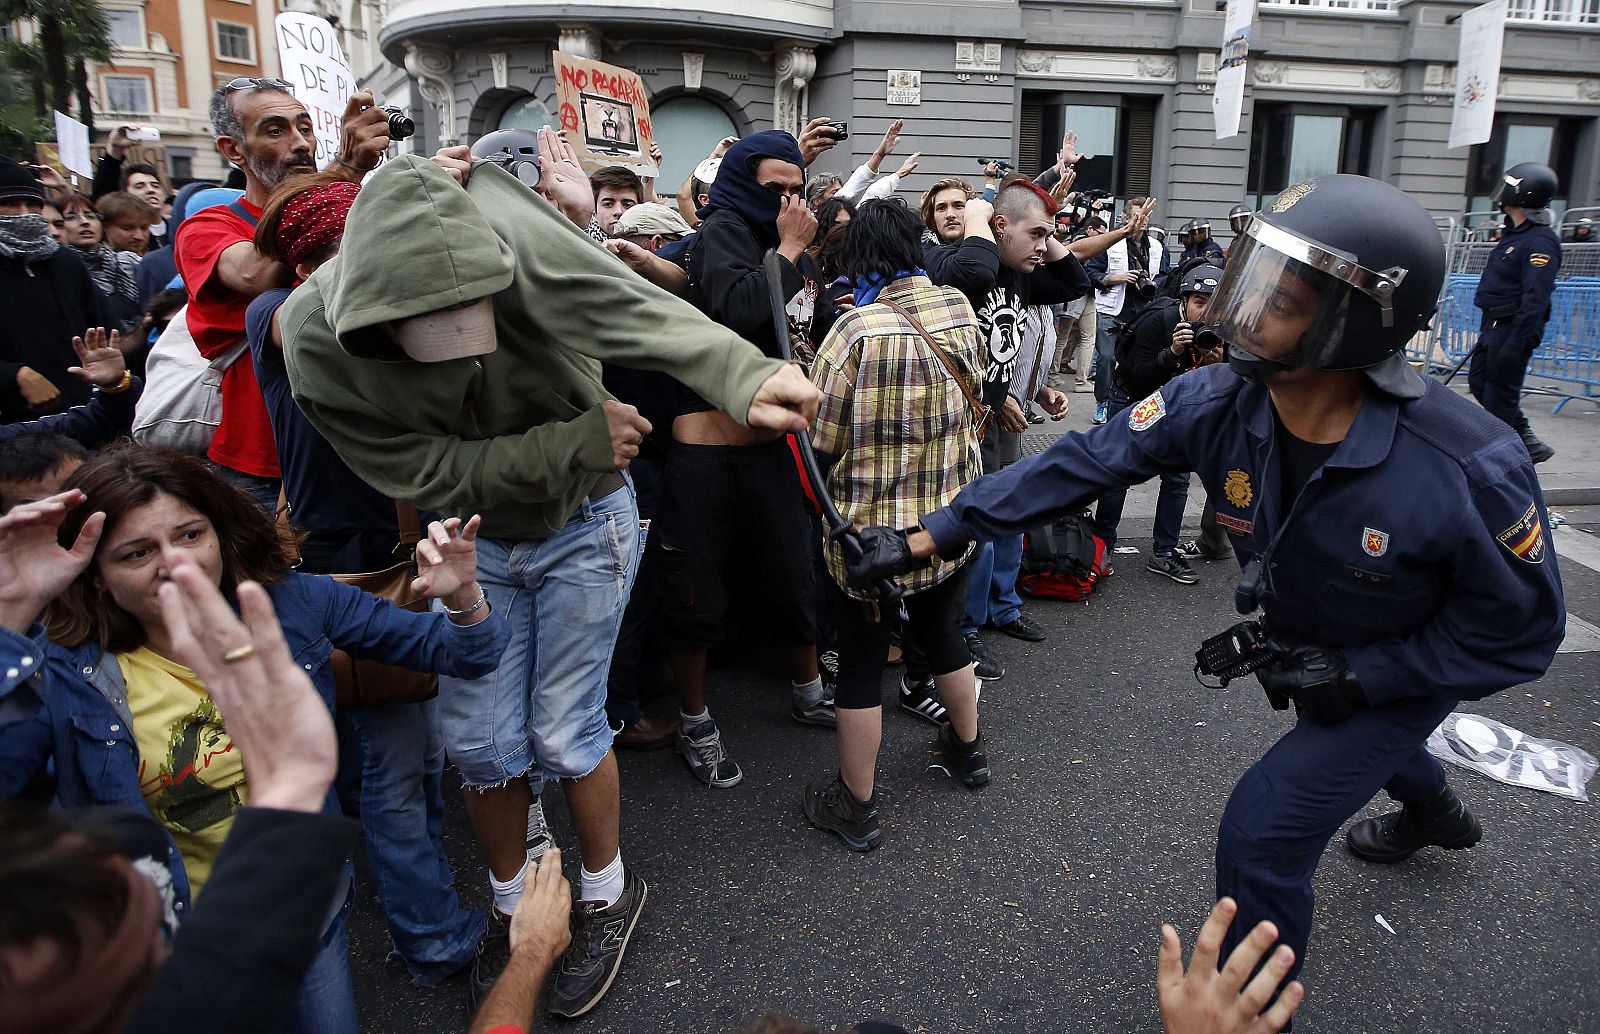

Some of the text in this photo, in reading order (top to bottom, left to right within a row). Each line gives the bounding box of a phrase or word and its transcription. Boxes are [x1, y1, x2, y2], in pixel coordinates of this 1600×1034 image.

[281, 22, 325, 53] NO
[300, 63, 329, 93] DE
[561, 64, 588, 92] NO
